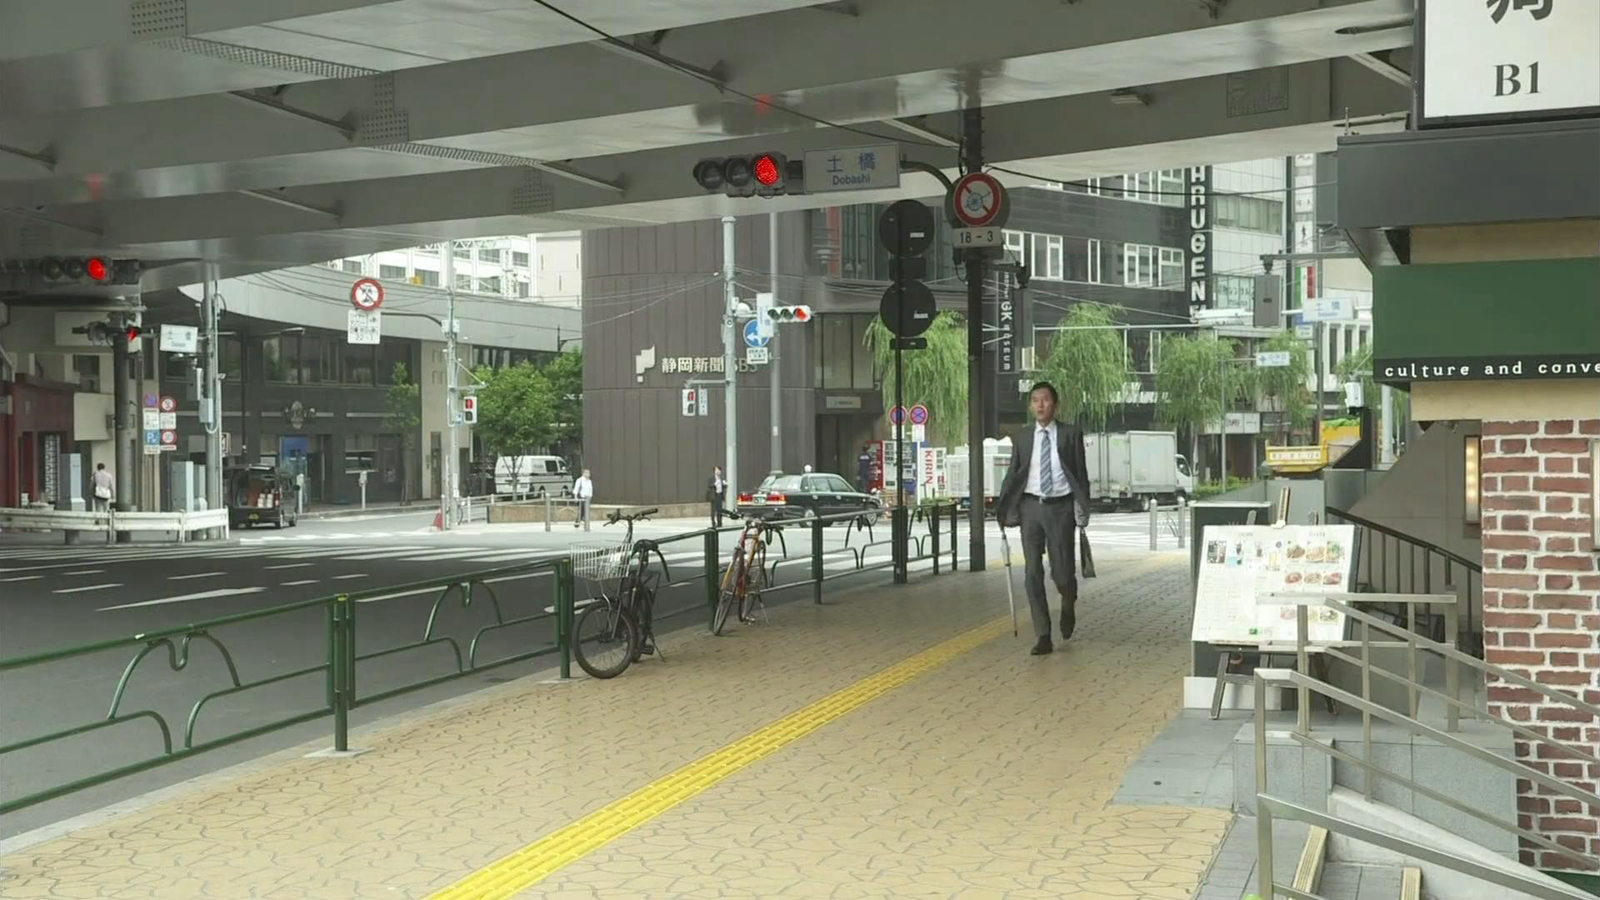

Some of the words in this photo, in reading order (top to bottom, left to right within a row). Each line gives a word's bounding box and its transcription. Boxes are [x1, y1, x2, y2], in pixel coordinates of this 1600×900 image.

[1493, 61, 1541, 97] B1
[826, 152, 876, 173] 土橋
[832, 173, 871, 186] Dobashi
[1000, 301, 1013, 321] GK
[661, 356, 725, 373] 静岡新聞
[1384, 363, 1470, 378] culture
[1484, 361, 1522, 375] and
[924, 450, 934, 484] KIRIN
